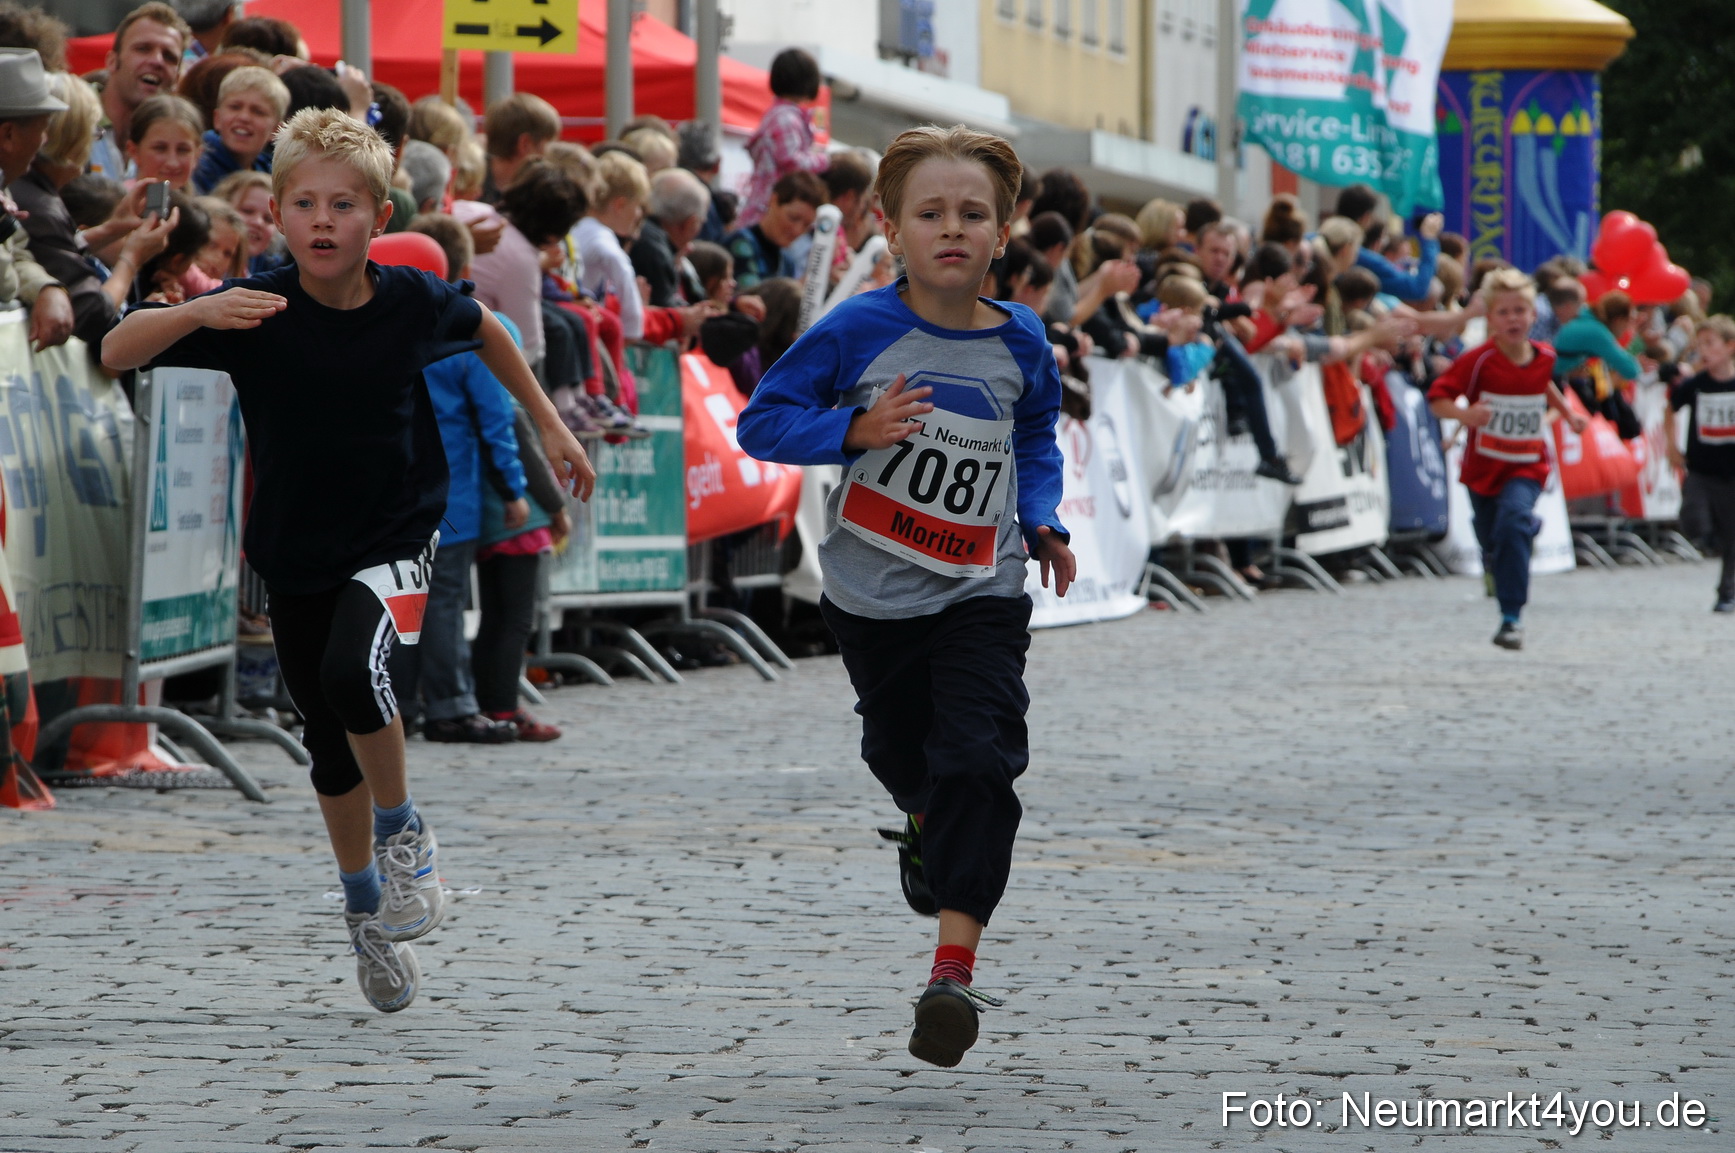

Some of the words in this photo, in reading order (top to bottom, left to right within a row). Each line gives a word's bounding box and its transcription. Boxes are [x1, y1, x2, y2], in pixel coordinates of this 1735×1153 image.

[935, 426, 1002, 453] Neumarkt
[877, 439, 1003, 517] 7087
[890, 511, 966, 558] Moritz
